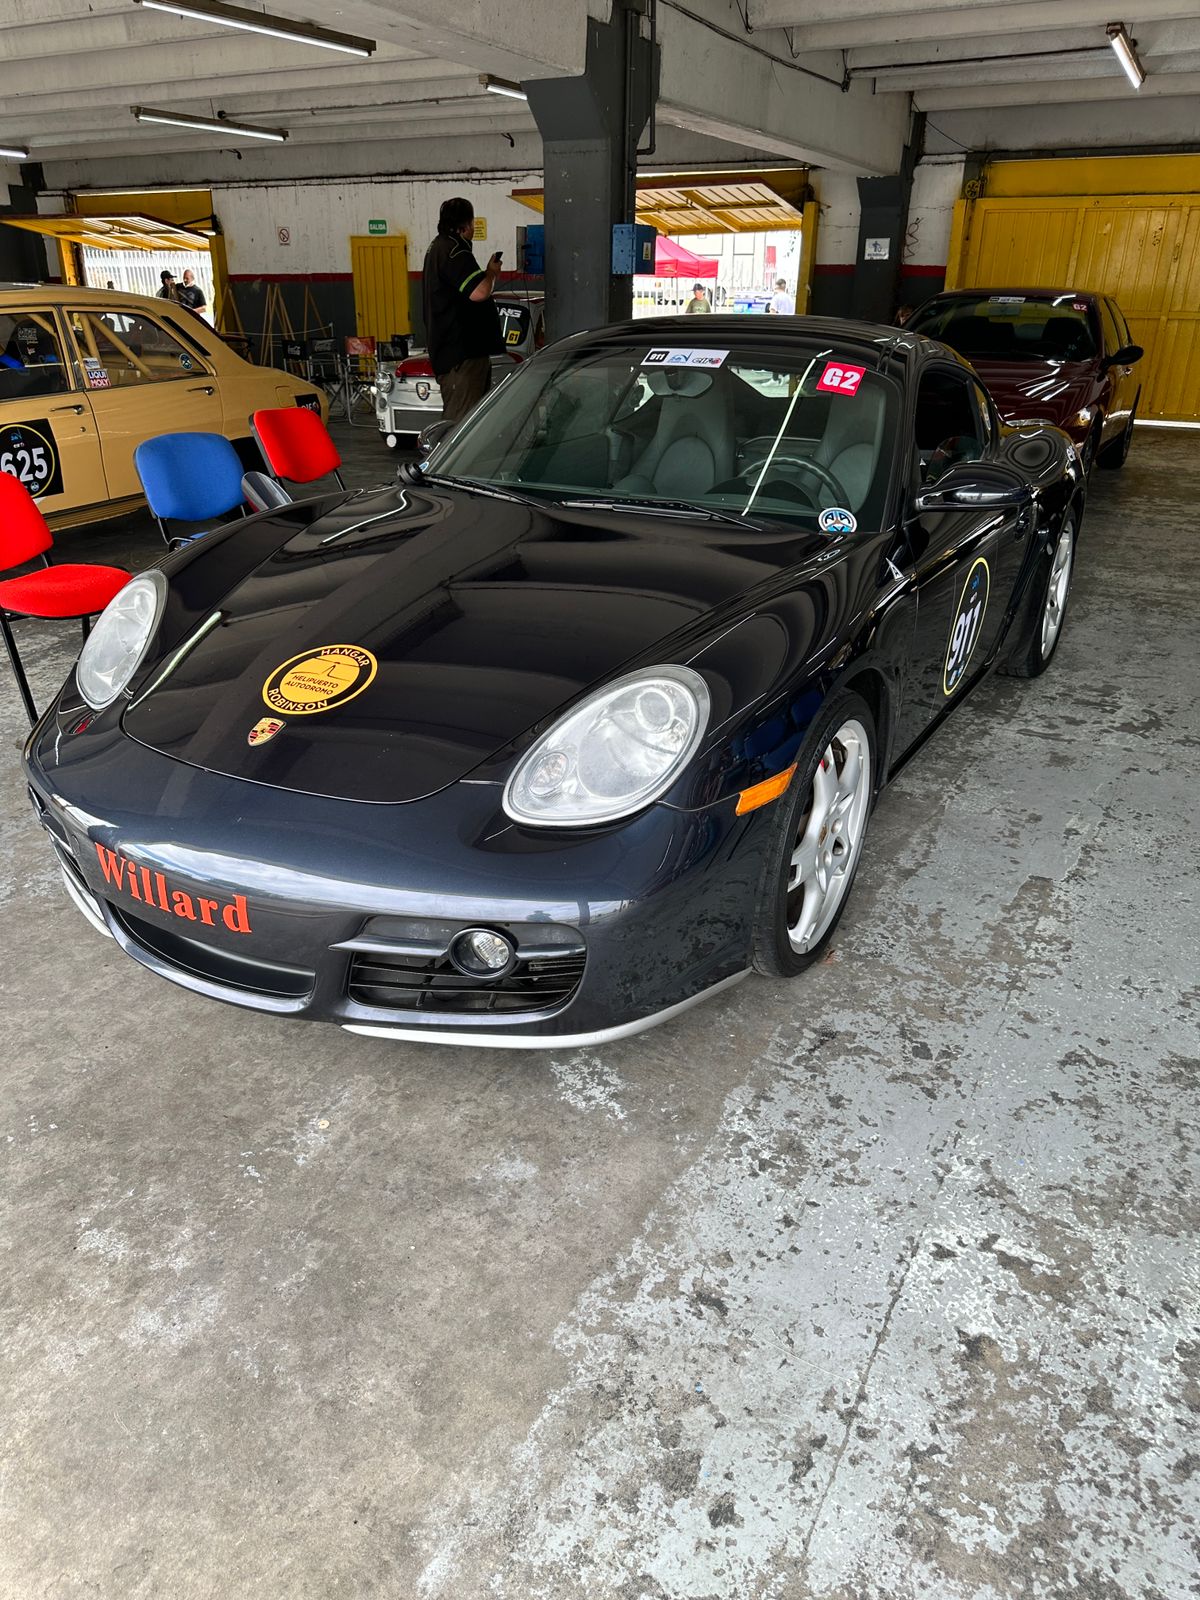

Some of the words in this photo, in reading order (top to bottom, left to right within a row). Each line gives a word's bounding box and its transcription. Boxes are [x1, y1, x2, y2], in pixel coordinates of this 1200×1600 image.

[1073, 303, 1087, 311] G2
[509, 332, 519, 341] G1
[87, 370, 107, 379] LIQUI
[90, 379, 109, 387] MOLY
[822, 367, 860, 391] G2
[0, 446, 48, 482] 625
[947, 600, 982, 671] 911
[321, 648, 370, 667] HANGAR
[285, 680, 334, 696] AUTODROMO
[292, 674, 339, 689] HELIPUERTO
[268, 687, 328, 711] ROBINSON
[95, 842, 252, 933] Willard
